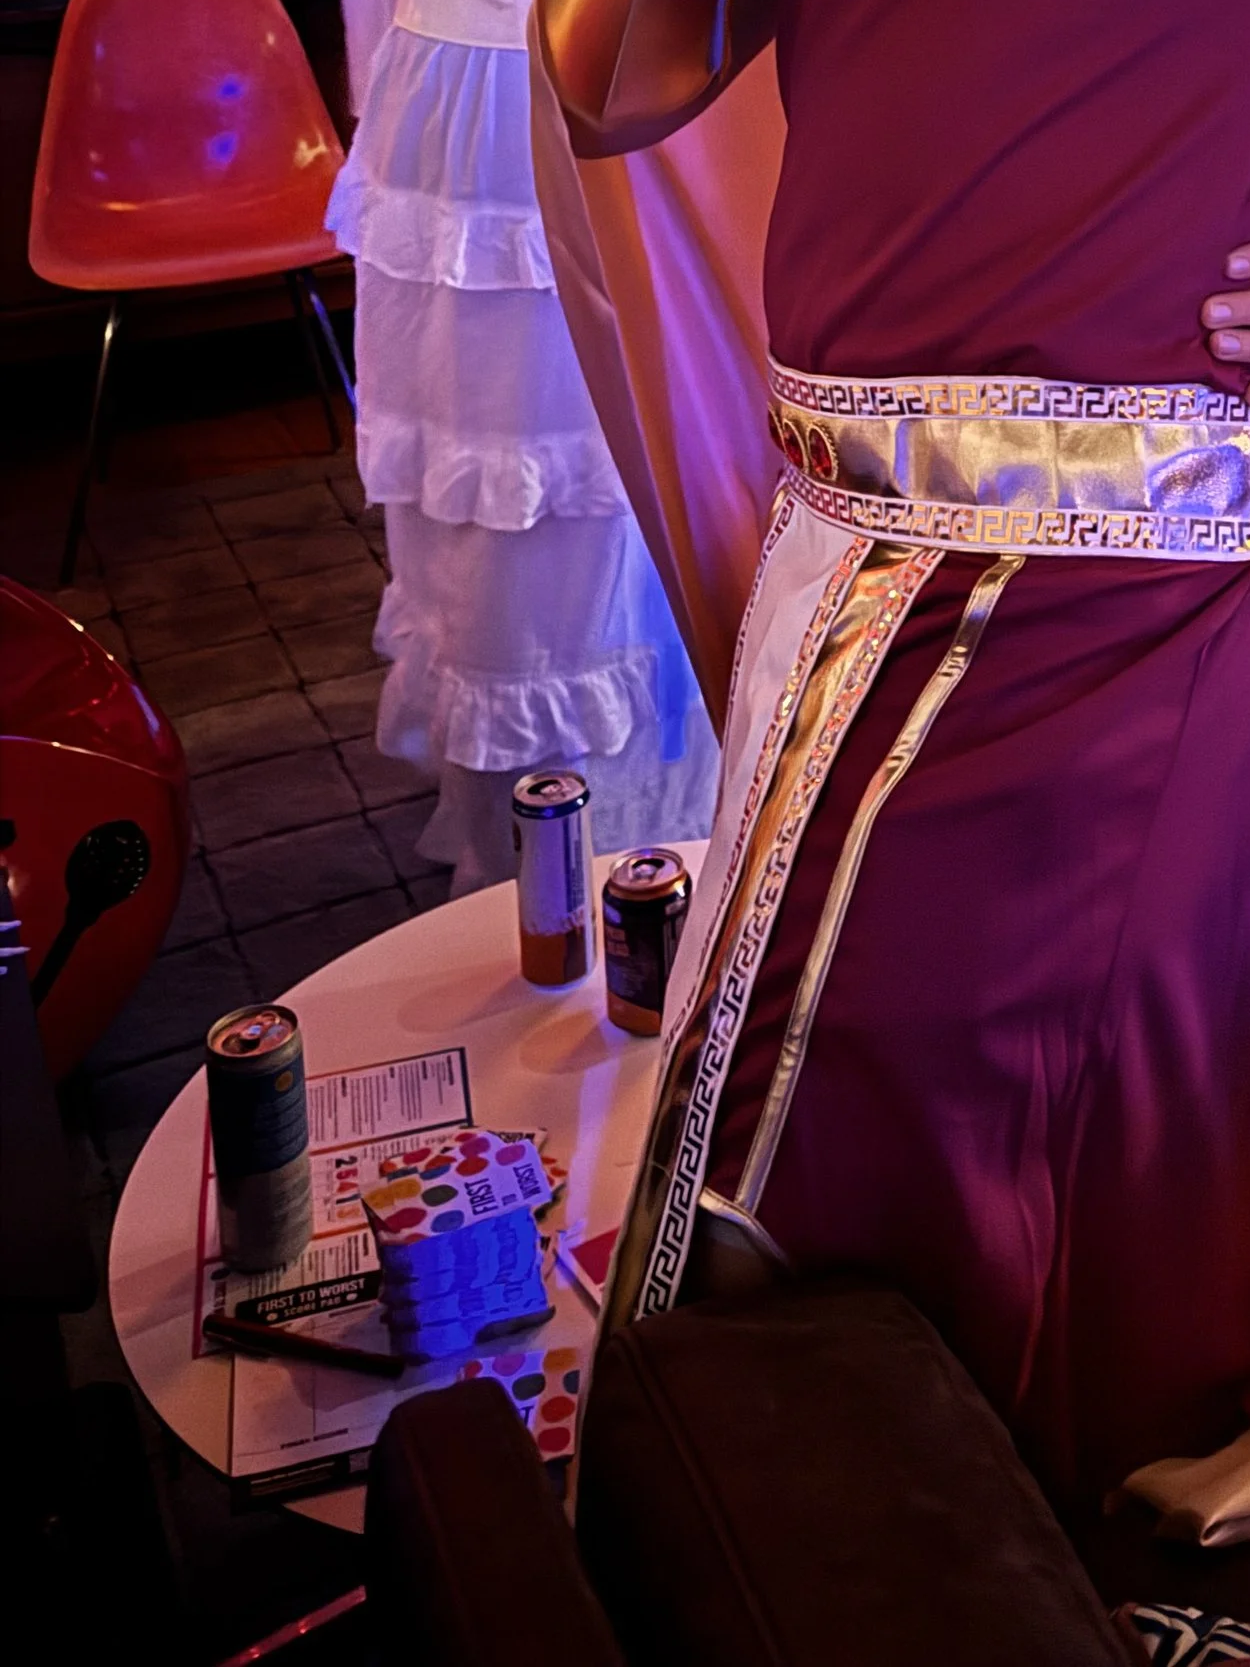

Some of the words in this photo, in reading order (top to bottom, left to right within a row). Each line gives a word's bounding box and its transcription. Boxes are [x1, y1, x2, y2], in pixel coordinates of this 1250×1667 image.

[464, 1178, 498, 1216] FIRST
[513, 1163, 542, 1200] WORST
[256, 1294, 296, 1314] FIRST
[300, 1289, 317, 1304] TO
[319, 1277, 366, 1298] WORST
